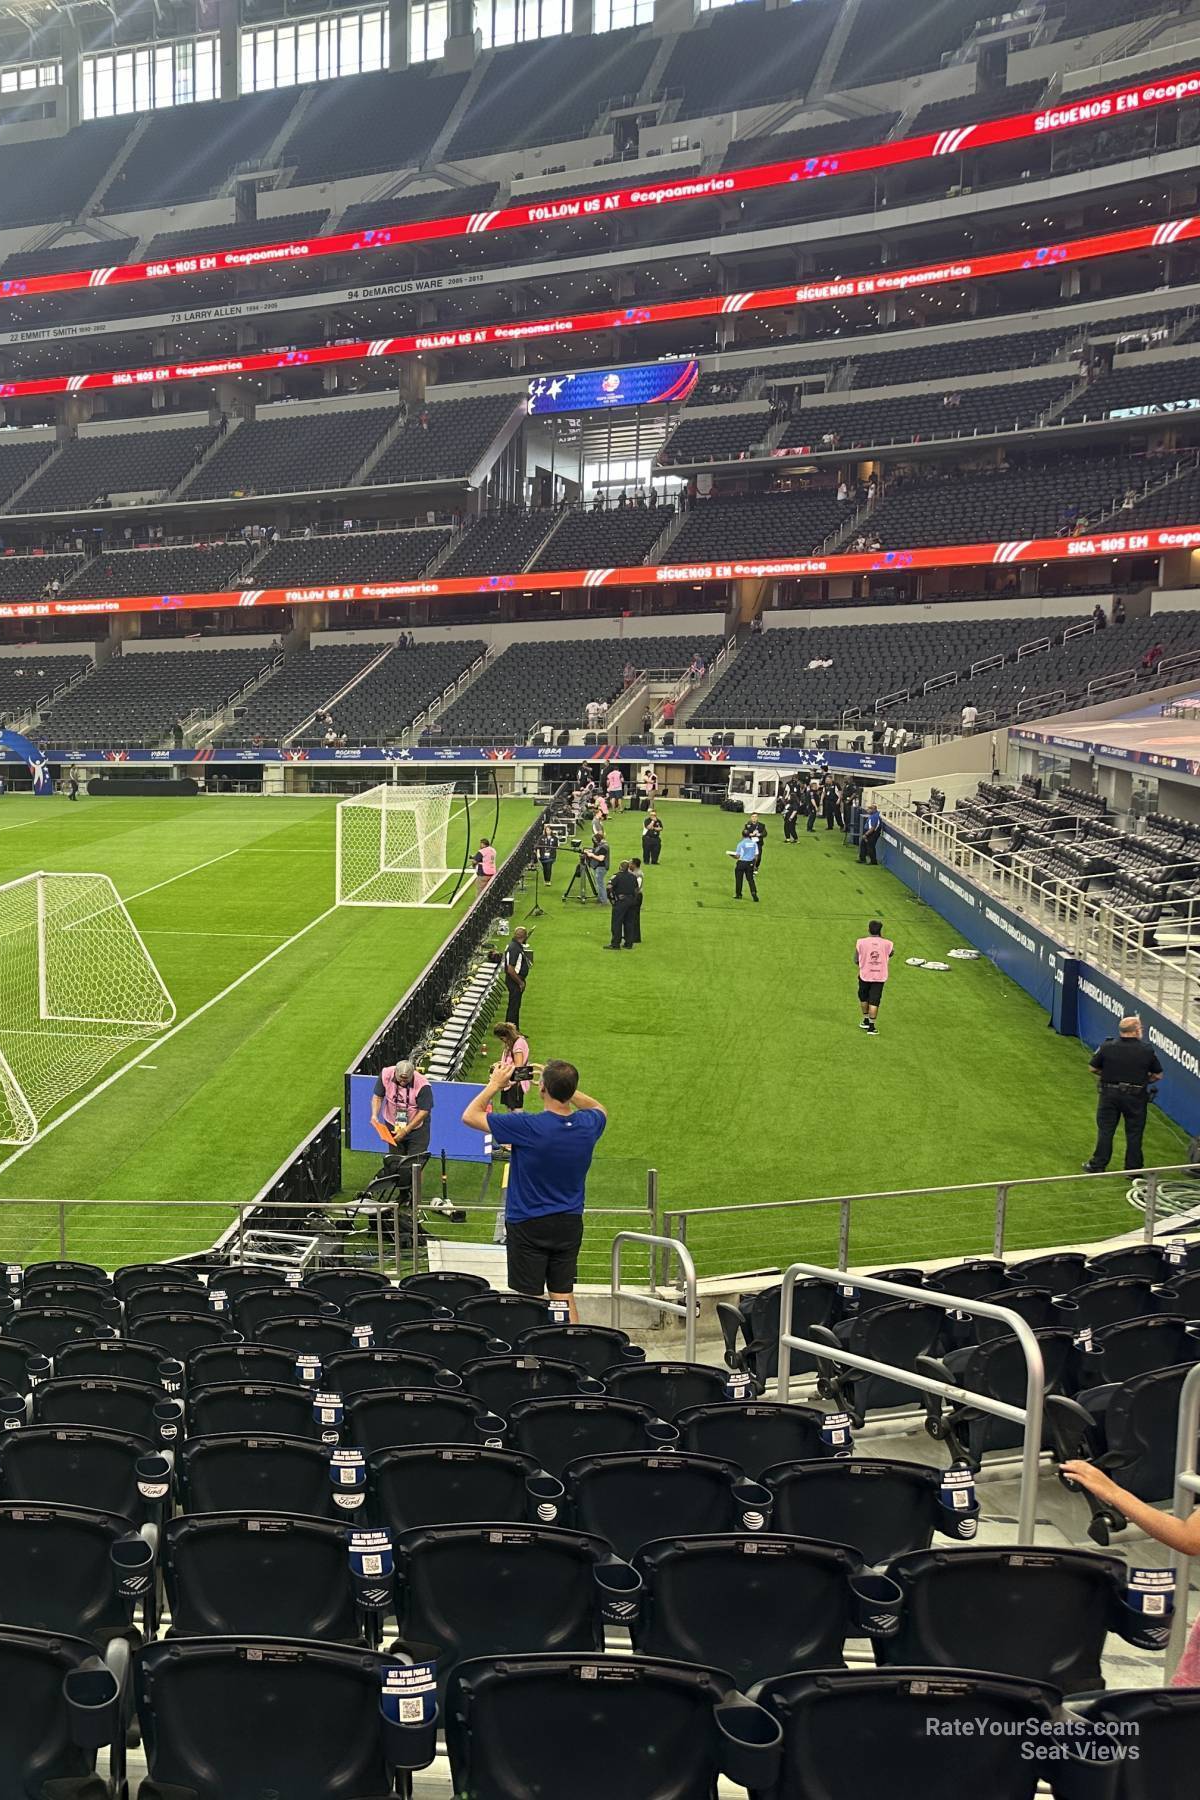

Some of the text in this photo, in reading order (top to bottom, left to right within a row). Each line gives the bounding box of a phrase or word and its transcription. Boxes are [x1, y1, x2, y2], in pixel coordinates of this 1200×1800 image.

[1116, 92, 1138, 110] EN
[1142, 79, 1200, 99] @copa
[529, 179, 734, 220] FOLLOW US AT @copaamerica
[200, 257, 216, 270] EM
[347, 291, 359, 300] 94
[415, 280, 443, 290] WARE
[857, 281, 874, 293] EN
[171, 314, 181, 323] 73
[184, 311, 212, 321] LARRY
[214, 307, 242, 317] ALLEN
[9, 334, 18, 342] 22
[21, 331, 51, 340] EMMITT
[53, 327, 77, 337] SMITH
[416, 322, 572, 348] FOLLOW US AT @copaamerica
[156, 370, 169, 380] EM
[1129, 535, 1148, 549] EM
[716, 565, 731, 577] EN
[285, 583, 439, 601] FOLLOW US AT @copaamerica
[1102, 992, 1112, 1012] USA
[1149, 1026, 1199, 1076] CONMEBOL COPA
[141, 1485, 164, 1495] Ford
[338, 1496, 360, 1506] Ford
